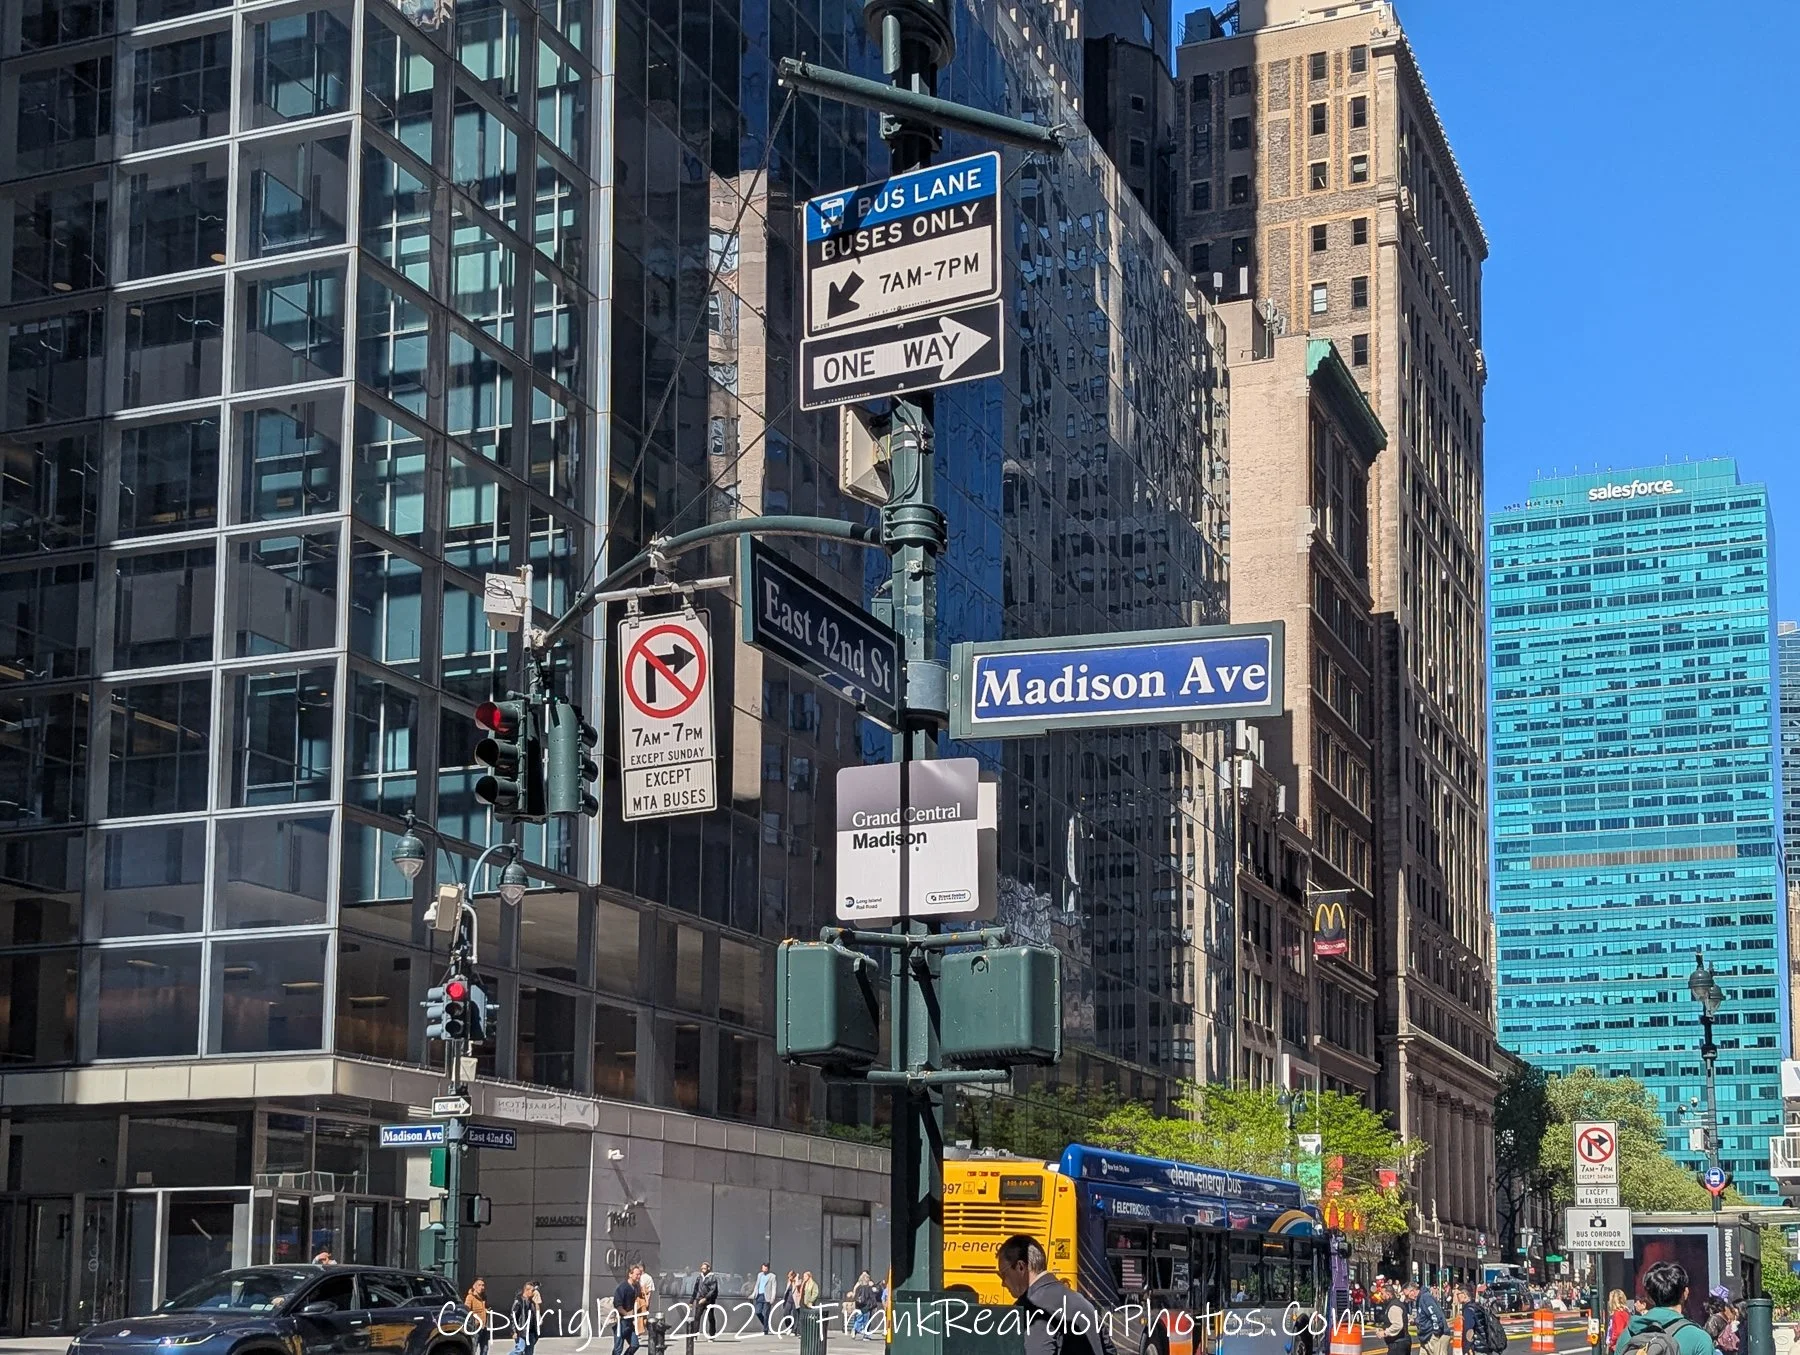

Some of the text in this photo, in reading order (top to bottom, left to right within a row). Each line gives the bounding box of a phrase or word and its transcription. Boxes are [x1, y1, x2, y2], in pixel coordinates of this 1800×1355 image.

[858, 168, 982, 217] BUS LANE
[821, 202, 980, 262] BUSES ONLY
[879, 252, 979, 294] 7AM-7PM
[823, 332, 961, 384] ONE WAY
[1588, 479, 1674, 500] salesforce
[763, 576, 891, 694] East 42nd St
[976, 656, 1266, 708] Madison Ave
[630, 747, 704, 766] EXCEPT SUNDAY
[645, 768, 691, 788] EXCEPT
[633, 788, 706, 812] MTA BUSES
[852, 802, 961, 828] Grand Central
[852, 830, 928, 850] Madison
[454, 1102, 466, 1110] WAY
[382, 1130, 443, 1142] Madison Ave
[468, 1130, 513, 1145] East 42nd St
[1170, 1164, 1242, 1196] clean-energy bus
[1724, 1228, 1734, 1277] Newsstand
